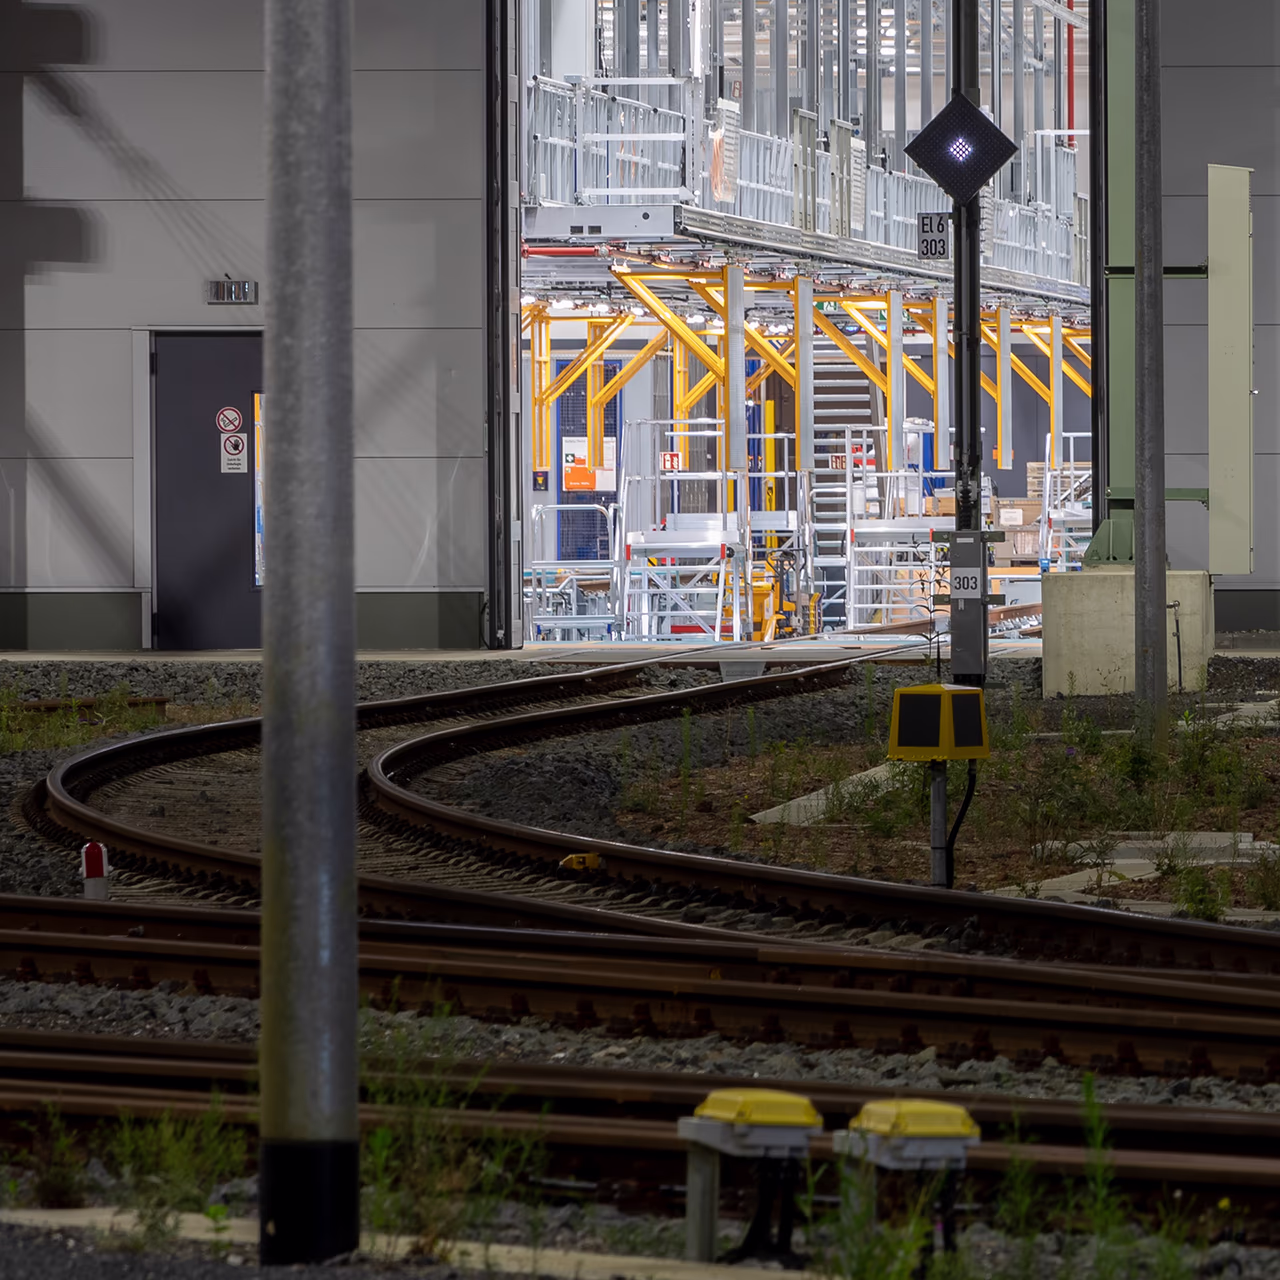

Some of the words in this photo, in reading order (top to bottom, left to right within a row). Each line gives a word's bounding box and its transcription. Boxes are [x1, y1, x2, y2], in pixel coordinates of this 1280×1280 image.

[937, 216, 945, 234] 6
[921, 238, 946, 256] 303
[954, 576, 978, 590] 303
